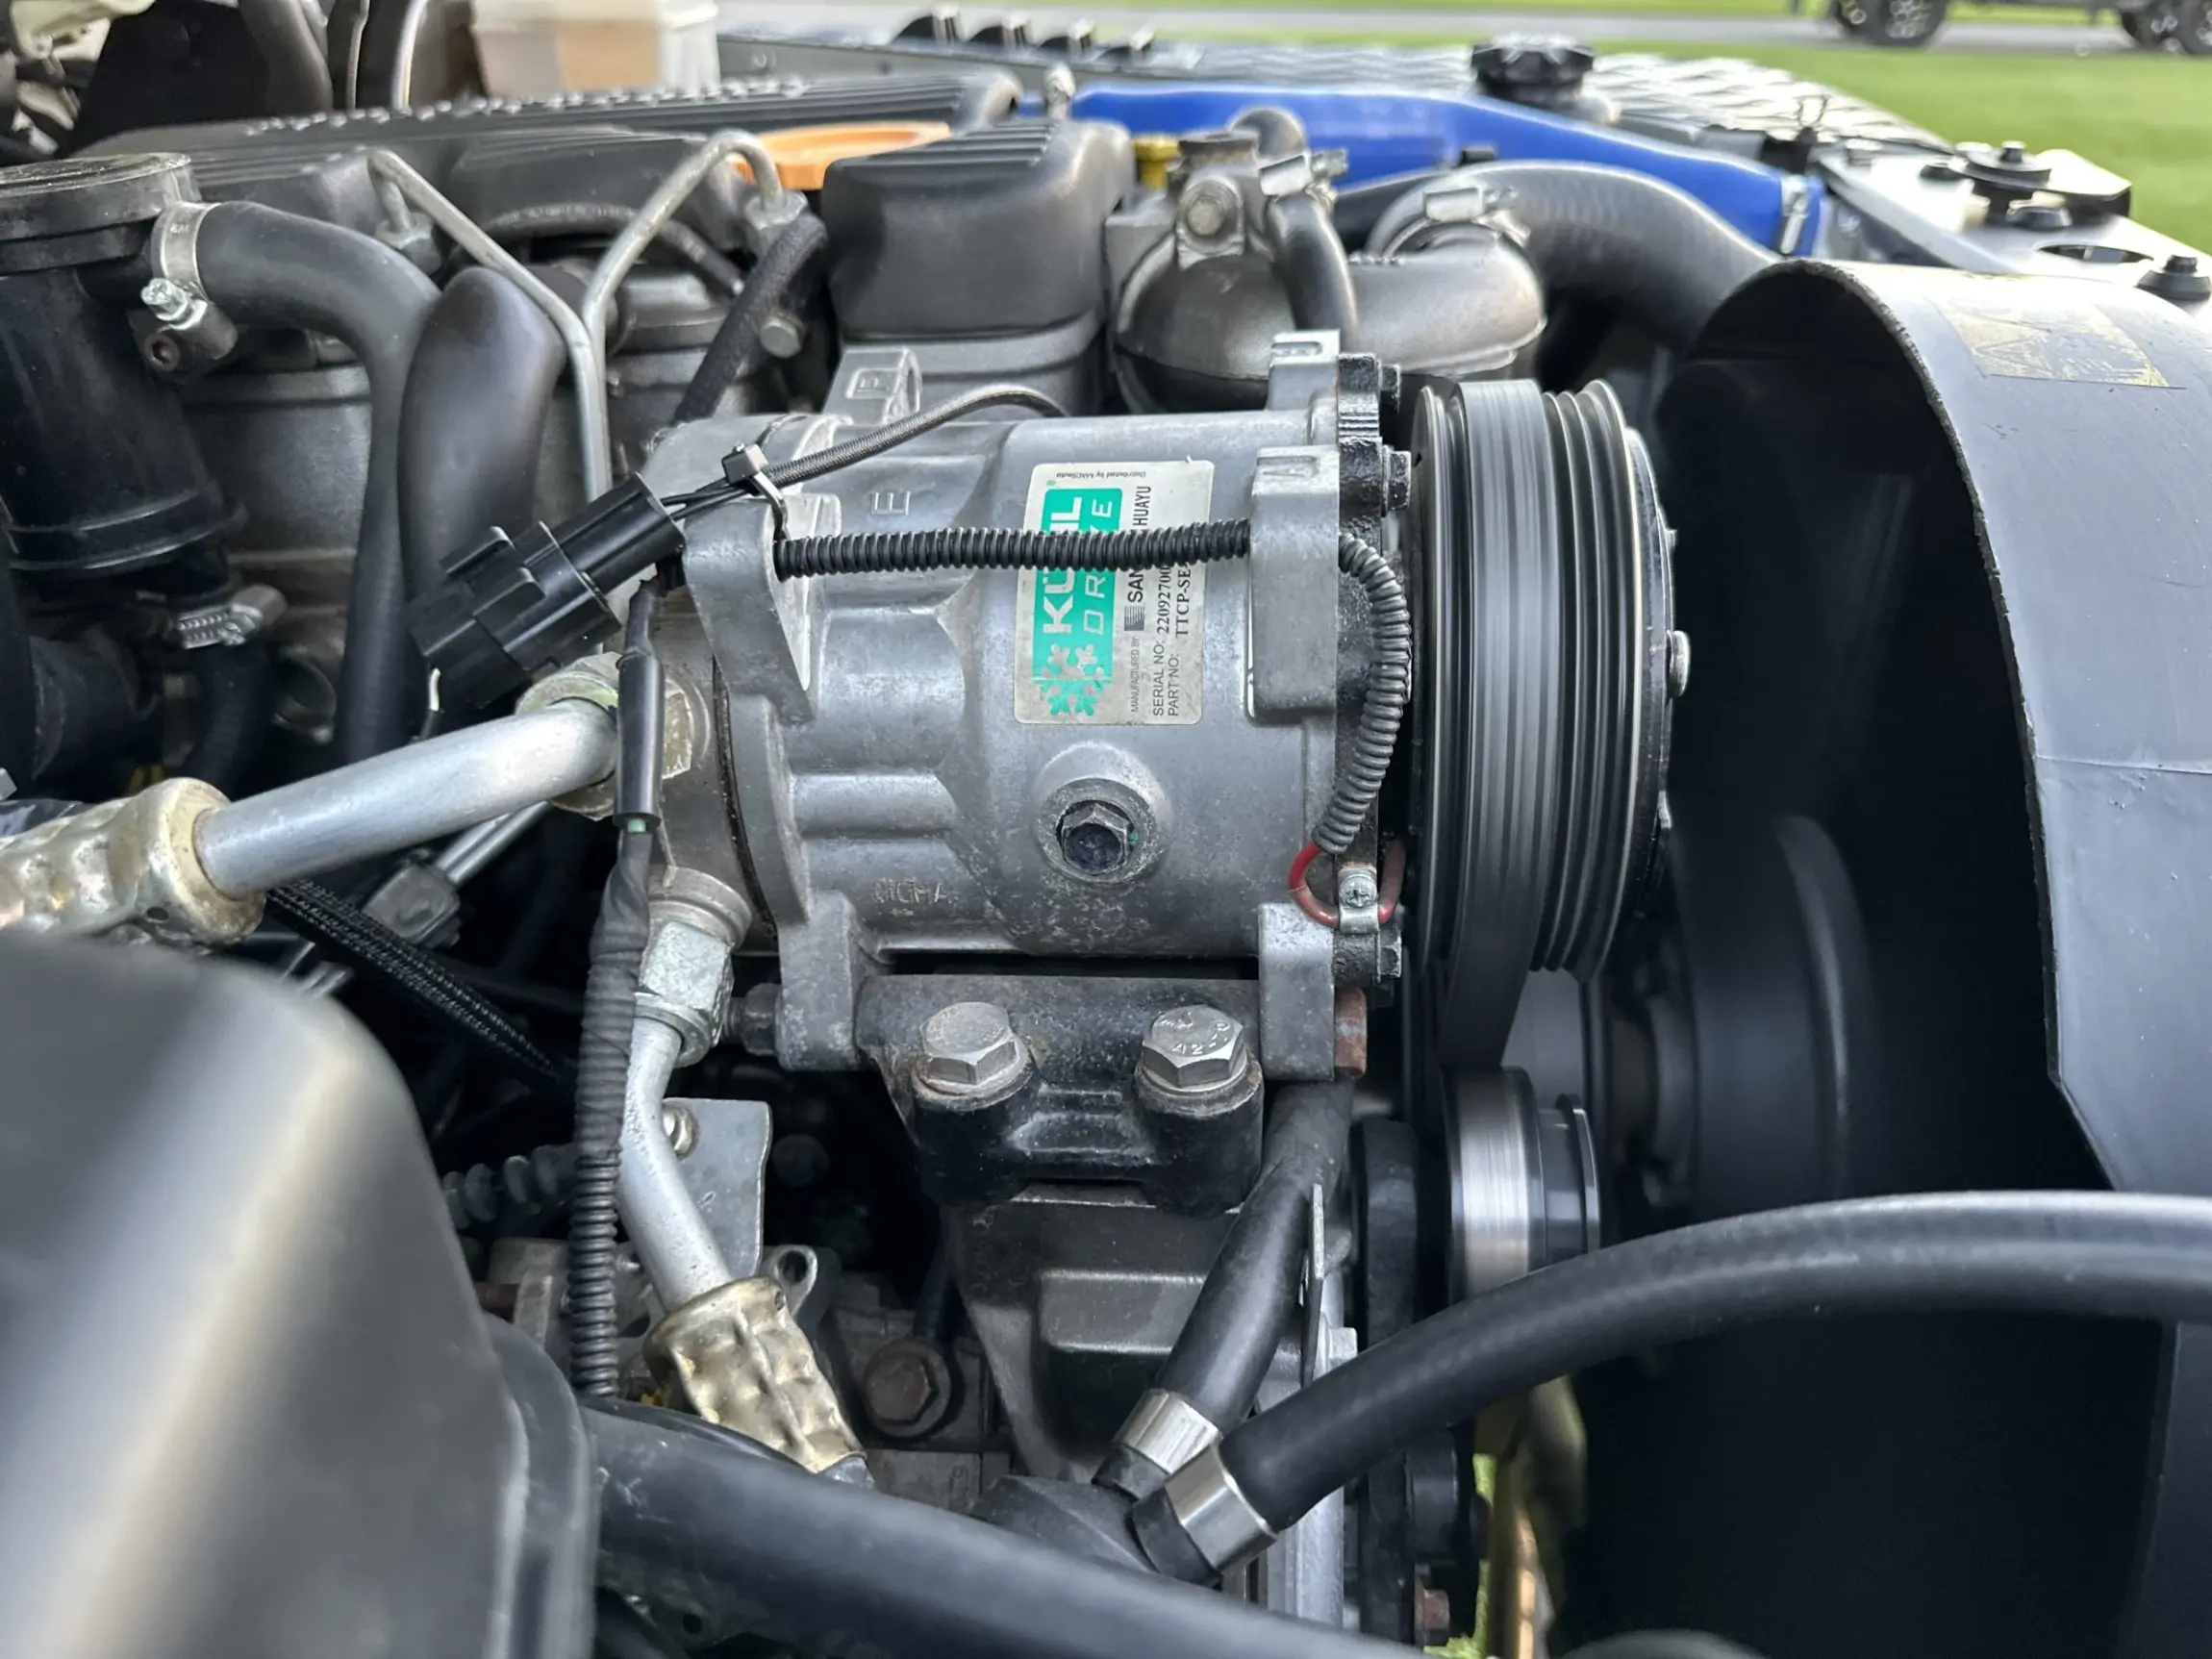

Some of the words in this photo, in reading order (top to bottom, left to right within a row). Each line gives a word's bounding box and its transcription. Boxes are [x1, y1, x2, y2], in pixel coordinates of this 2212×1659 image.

[1132, 486, 1151, 526] HUAYU
[1131, 637, 1140, 647] BY
[1153, 641, 1165, 665] NO:
[1130, 649, 1140, 713] MANUFACTURED
[1168, 653, 1179, 678] NO:
[1153, 667, 1165, 716] SERIAL
[1168, 680, 1179, 716] PART
